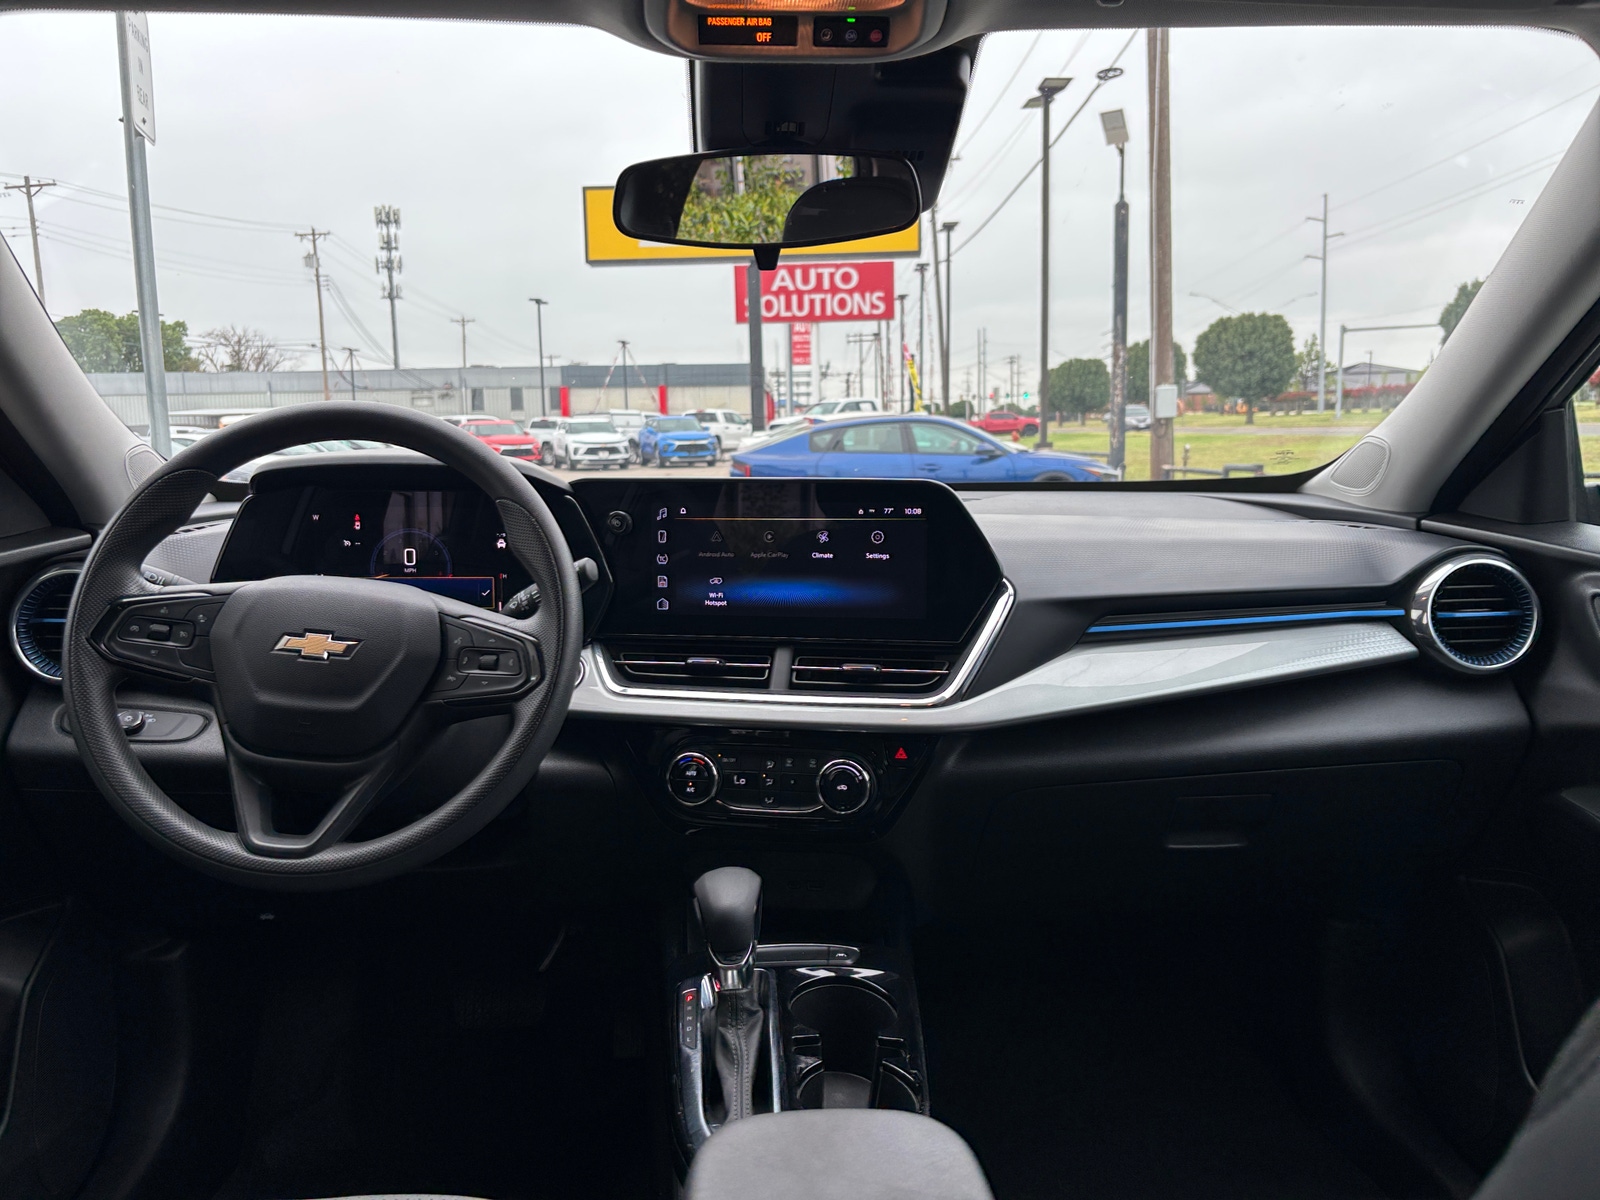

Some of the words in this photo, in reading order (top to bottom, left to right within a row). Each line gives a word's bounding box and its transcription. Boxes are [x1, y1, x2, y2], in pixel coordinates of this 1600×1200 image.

[707, 17, 745, 26] PASSENGER
[746, 17, 758, 26] AIR
[758, 17, 772, 27] BAG
[756, 32, 772, 42] OFF
[771, 267, 859, 291] AUTO
[904, 507, 922, 515] 10:08
[404, 548, 416, 566] 0
[750, 551, 766, 559] Apple
[767, 551, 789, 559] CarPlay
[812, 551, 833, 559] Climate
[865, 552, 890, 560] Settings
[704, 599, 727, 607] Hotspot
[733, 775, 747, 785] Lo
